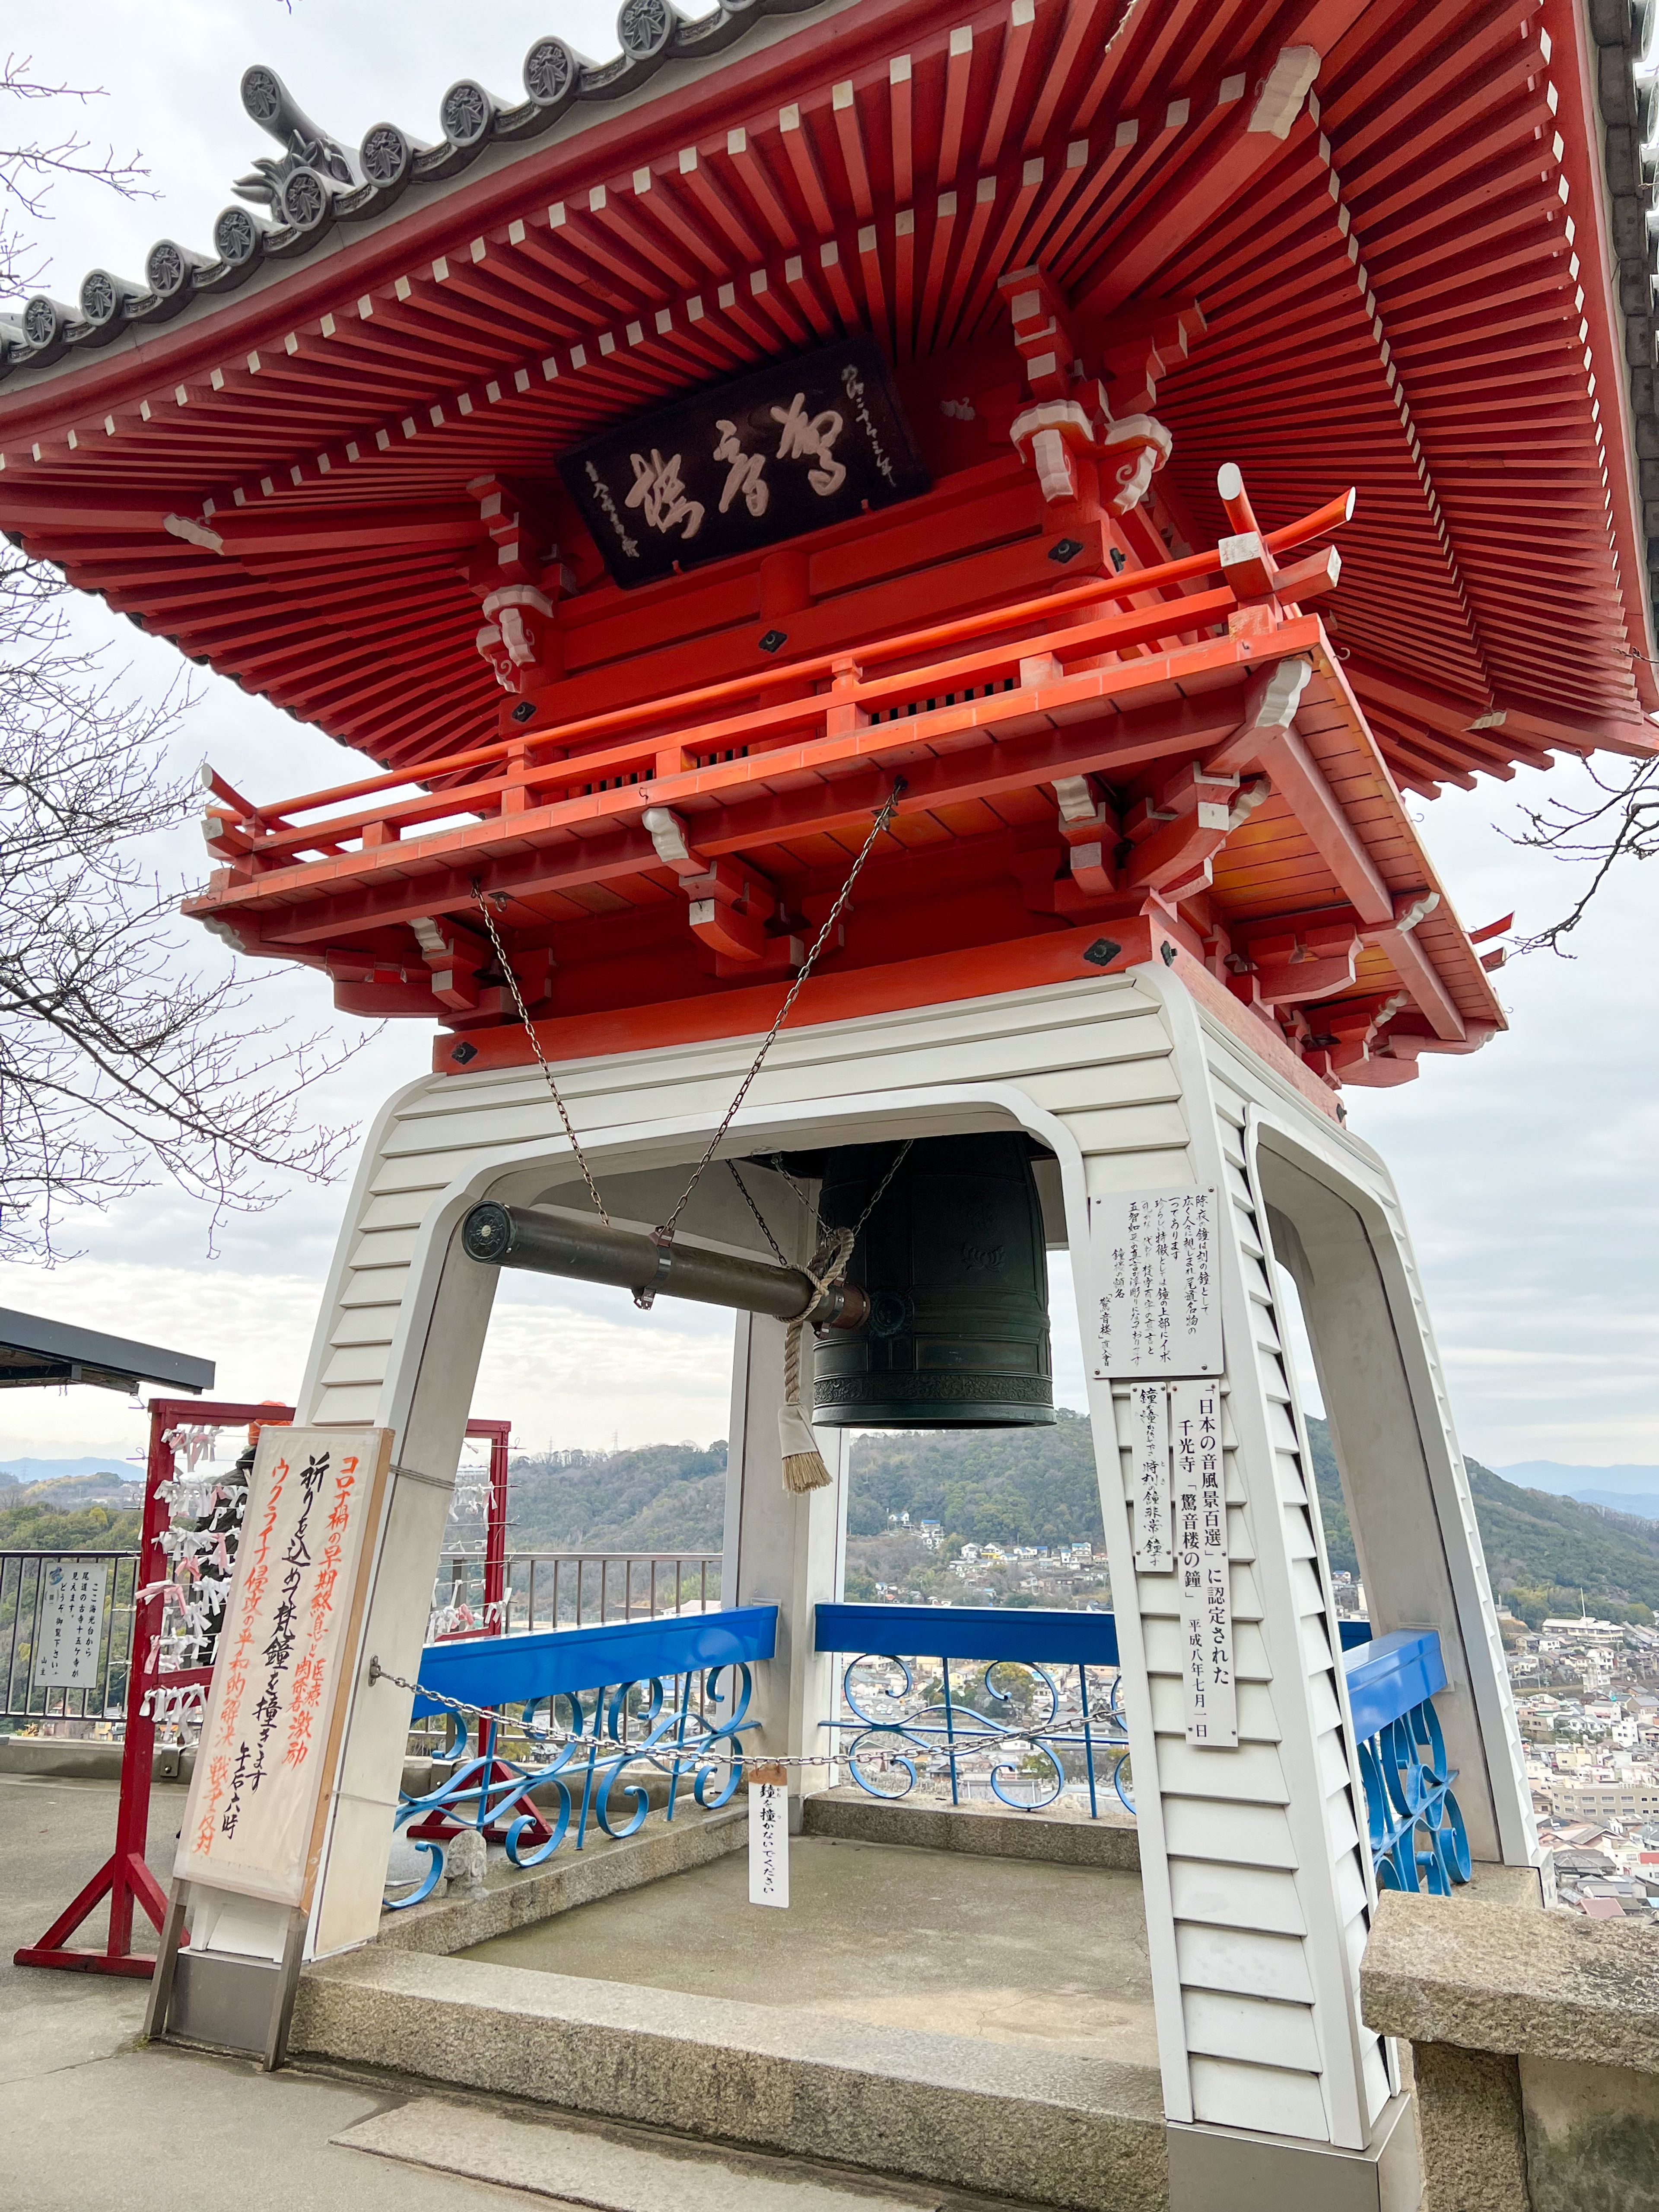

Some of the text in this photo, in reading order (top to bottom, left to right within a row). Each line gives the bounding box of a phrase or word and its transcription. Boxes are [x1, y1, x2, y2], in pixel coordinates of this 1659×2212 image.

[85, 1583, 98, 1658] ここ海光台から
[1188, 1618, 1208, 1738] 平成八年七月一日
[760, 1783, 776, 1894] 鐘を撞かないでください
